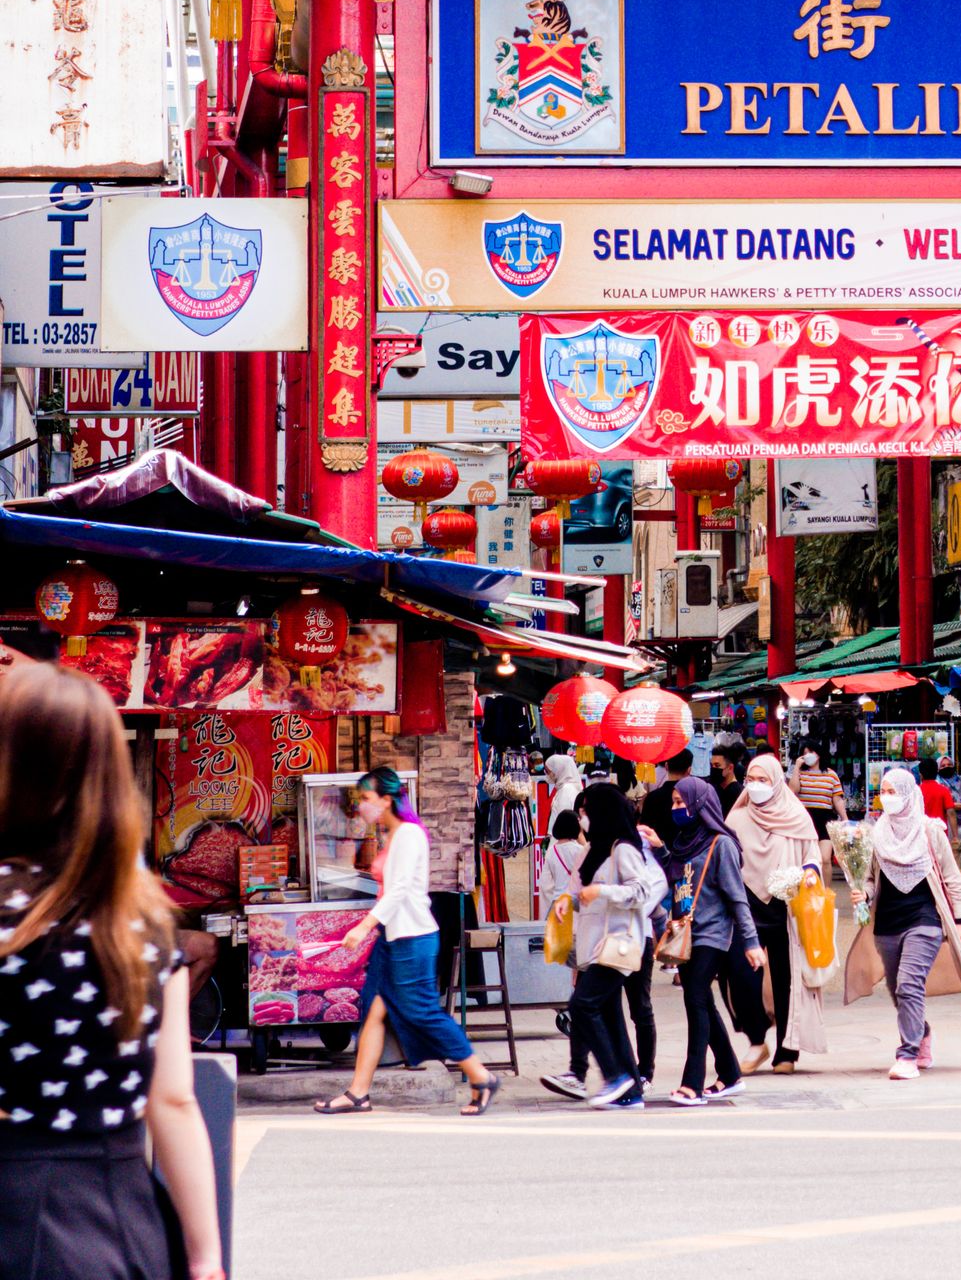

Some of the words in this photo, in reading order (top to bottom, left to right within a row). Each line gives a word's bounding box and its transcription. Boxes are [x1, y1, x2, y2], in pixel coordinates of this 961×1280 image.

[492, 108, 518, 127] Dewan
[519, 124, 560, 142] Bandaraya
[561, 125, 582, 137] Kuala
[583, 105, 609, 126] Lumpur
[593, 228, 727, 261] SELAMAT
[736, 228, 856, 261] DATANG
[178, 292, 203, 309] KUALA
[205, 294, 235, 309] LUMPUR
[603, 288, 648, 299] KUALA
[651, 288, 707, 299] LUMPUR
[711, 287, 780, 299] HAWKERS'
[784, 287, 793, 298] &
[796, 287, 837, 298] PETTY
[841, 287, 906, 298] TRADES'
[191, 309, 214, 317] PETTY
[3, 322, 29, 345] TEL
[42, 322, 98, 345] 03-2857
[692, 318, 837, 343] 新年快乐
[437, 342, 521, 377] Say
[112, 368, 153, 407] 24
[155, 352, 196, 403] JAM
[574, 404, 598, 421] KUALA
[600, 404, 631, 421] LUMPUR
[586, 421, 611, 430] PETTY
[685, 443, 751, 456] PERSATUAN
[753, 442, 799, 455] PENJAJA
[801, 442, 826, 454] DAN
[828, 441, 876, 454] PENIAGA
[878, 441, 908, 453] KECIL
[909, 441, 930, 453] K.L.
[807, 516, 831, 524] SAYANGI
[852, 515, 877, 523] LUMPUR
[304, 607, 334, 643] 龍記
[189, 779, 240, 797] LOONG
[194, 797, 236, 812] KEE
